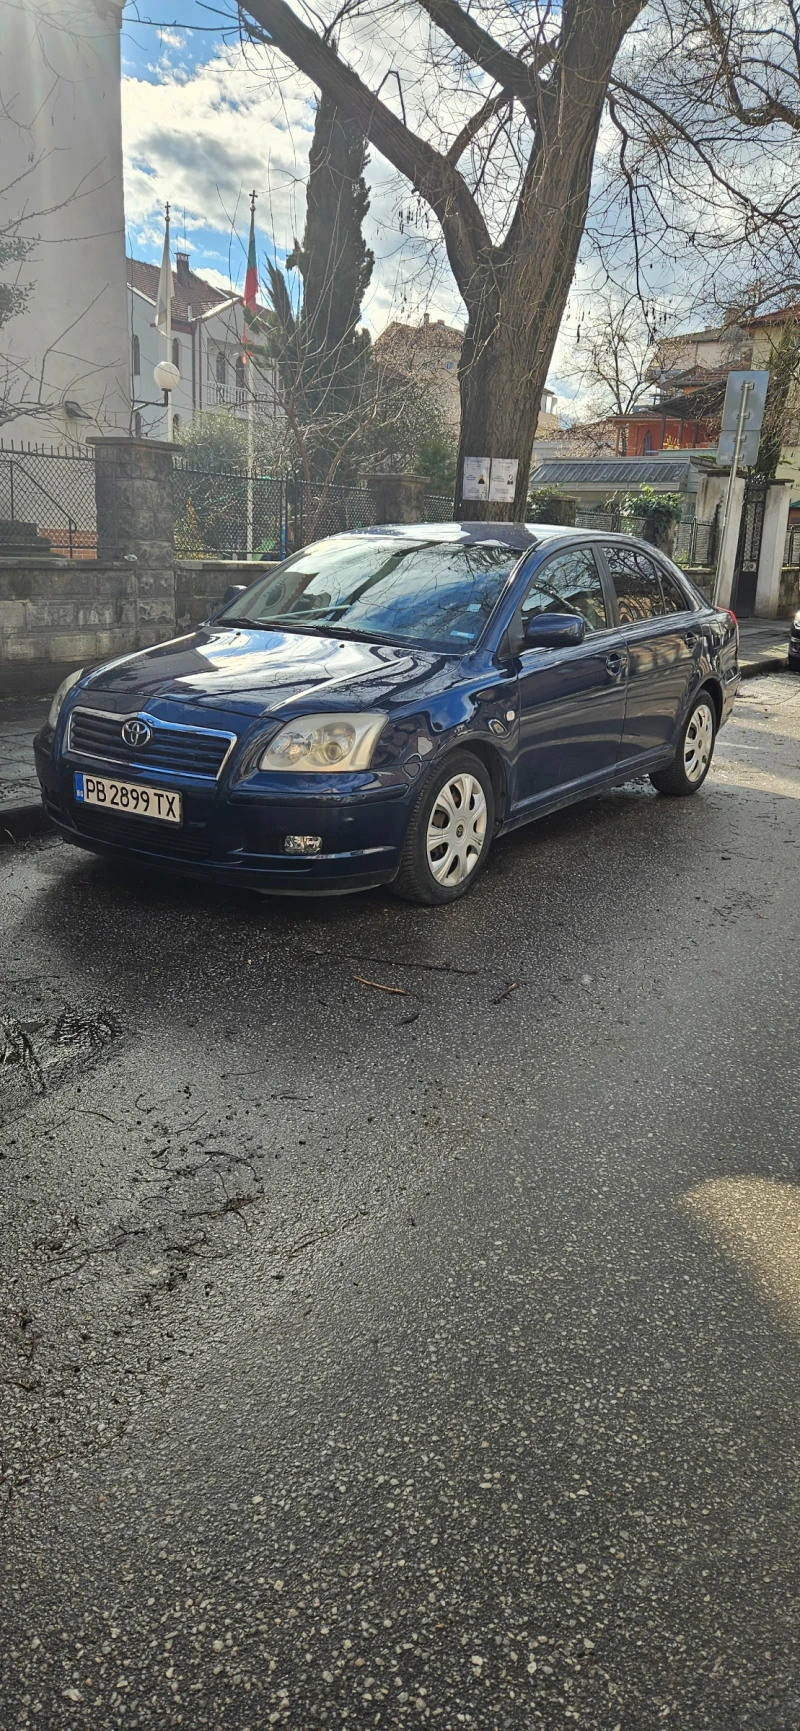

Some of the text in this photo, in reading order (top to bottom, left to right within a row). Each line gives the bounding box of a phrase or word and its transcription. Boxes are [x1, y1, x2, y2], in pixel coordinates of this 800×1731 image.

[86, 779, 176, 818] PB 2899 TX
